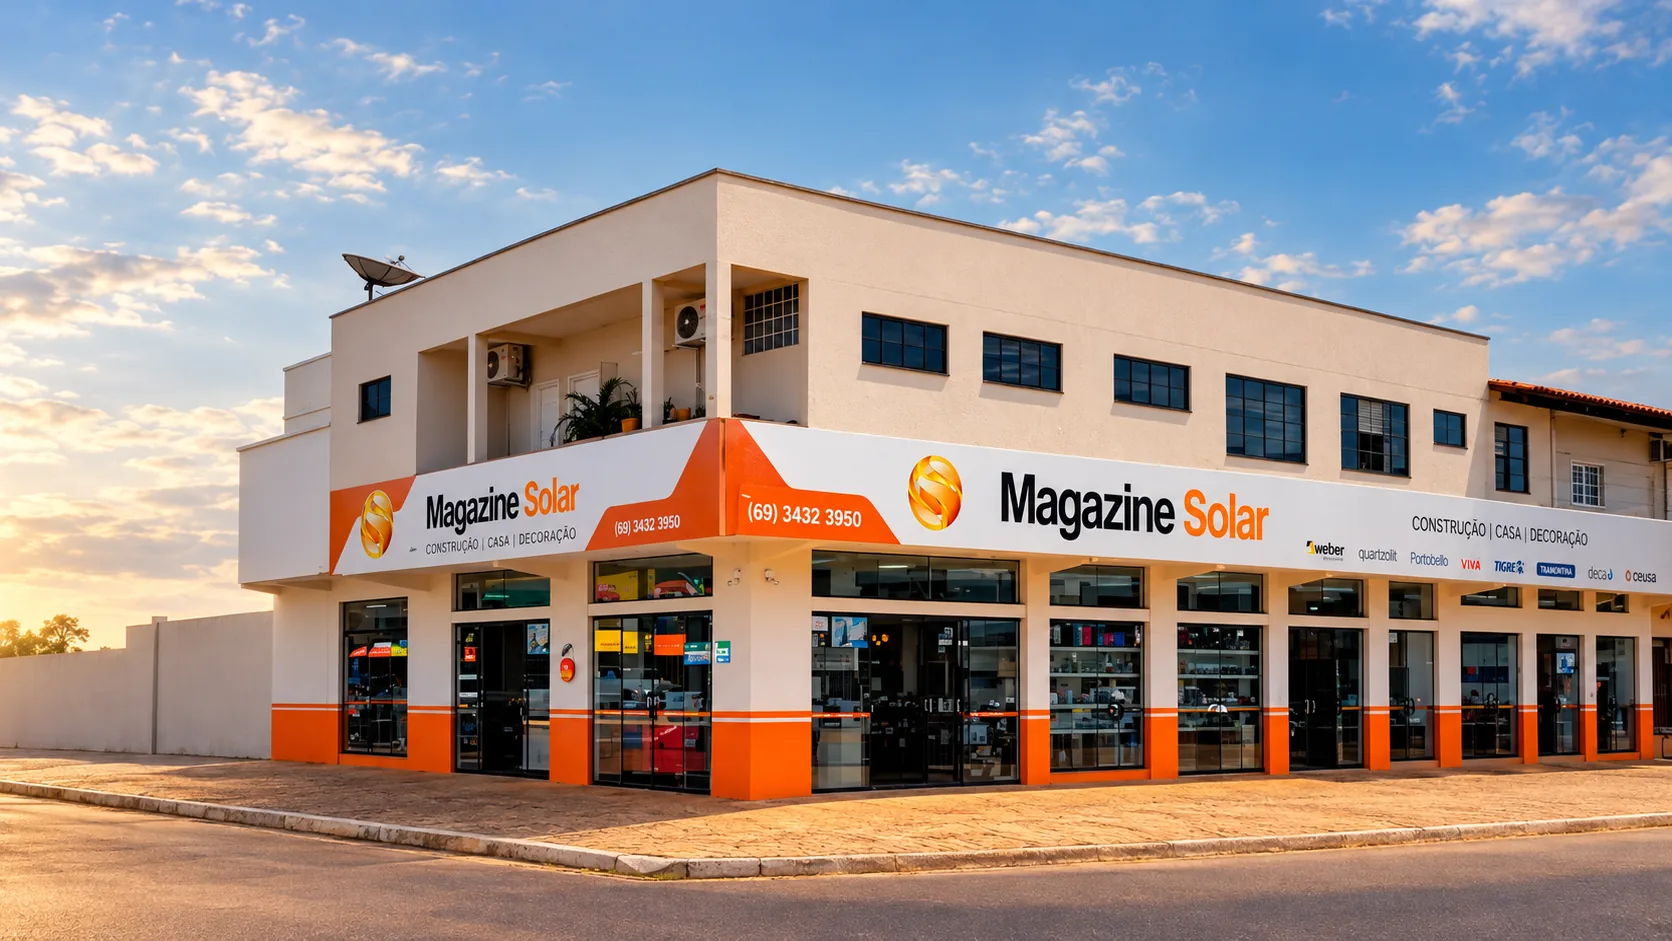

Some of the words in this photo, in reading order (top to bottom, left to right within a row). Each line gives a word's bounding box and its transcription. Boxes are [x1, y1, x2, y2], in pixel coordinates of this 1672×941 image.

[426, 486, 519, 536] Magazine
[524, 477, 580, 517] Solar
[747, 500, 778, 525] (69)
[782, 504, 821, 526] 3432
[824, 507, 862, 528] 3950
[1001, 471, 1175, 541] Magazine
[1183, 488, 1270, 541] Solar
[614, 521, 631, 537] (69)
[633, 517, 655, 534] 3432
[657, 514, 681, 531] 3950
[1412, 515, 1486, 540] CONSTRUÇÃO
[1495, 524, 1522, 540] CASA
[1530, 527, 1588, 548] DECORAÇÃO
[425, 536, 479, 556] CONSTRUÇÃO
[487, 534, 510, 549] CASA
[519, 525, 577, 546] DECORAÇÃO
[1314, 542, 1345, 557] weber
[1410, 551, 1449, 567] Portobello
[1461, 558, 1481, 571] VIVA
[1494, 560, 1516, 574] TIGRE
[1588, 566, 1607, 580] deca
[1632, 570, 1656, 583] ceusa
